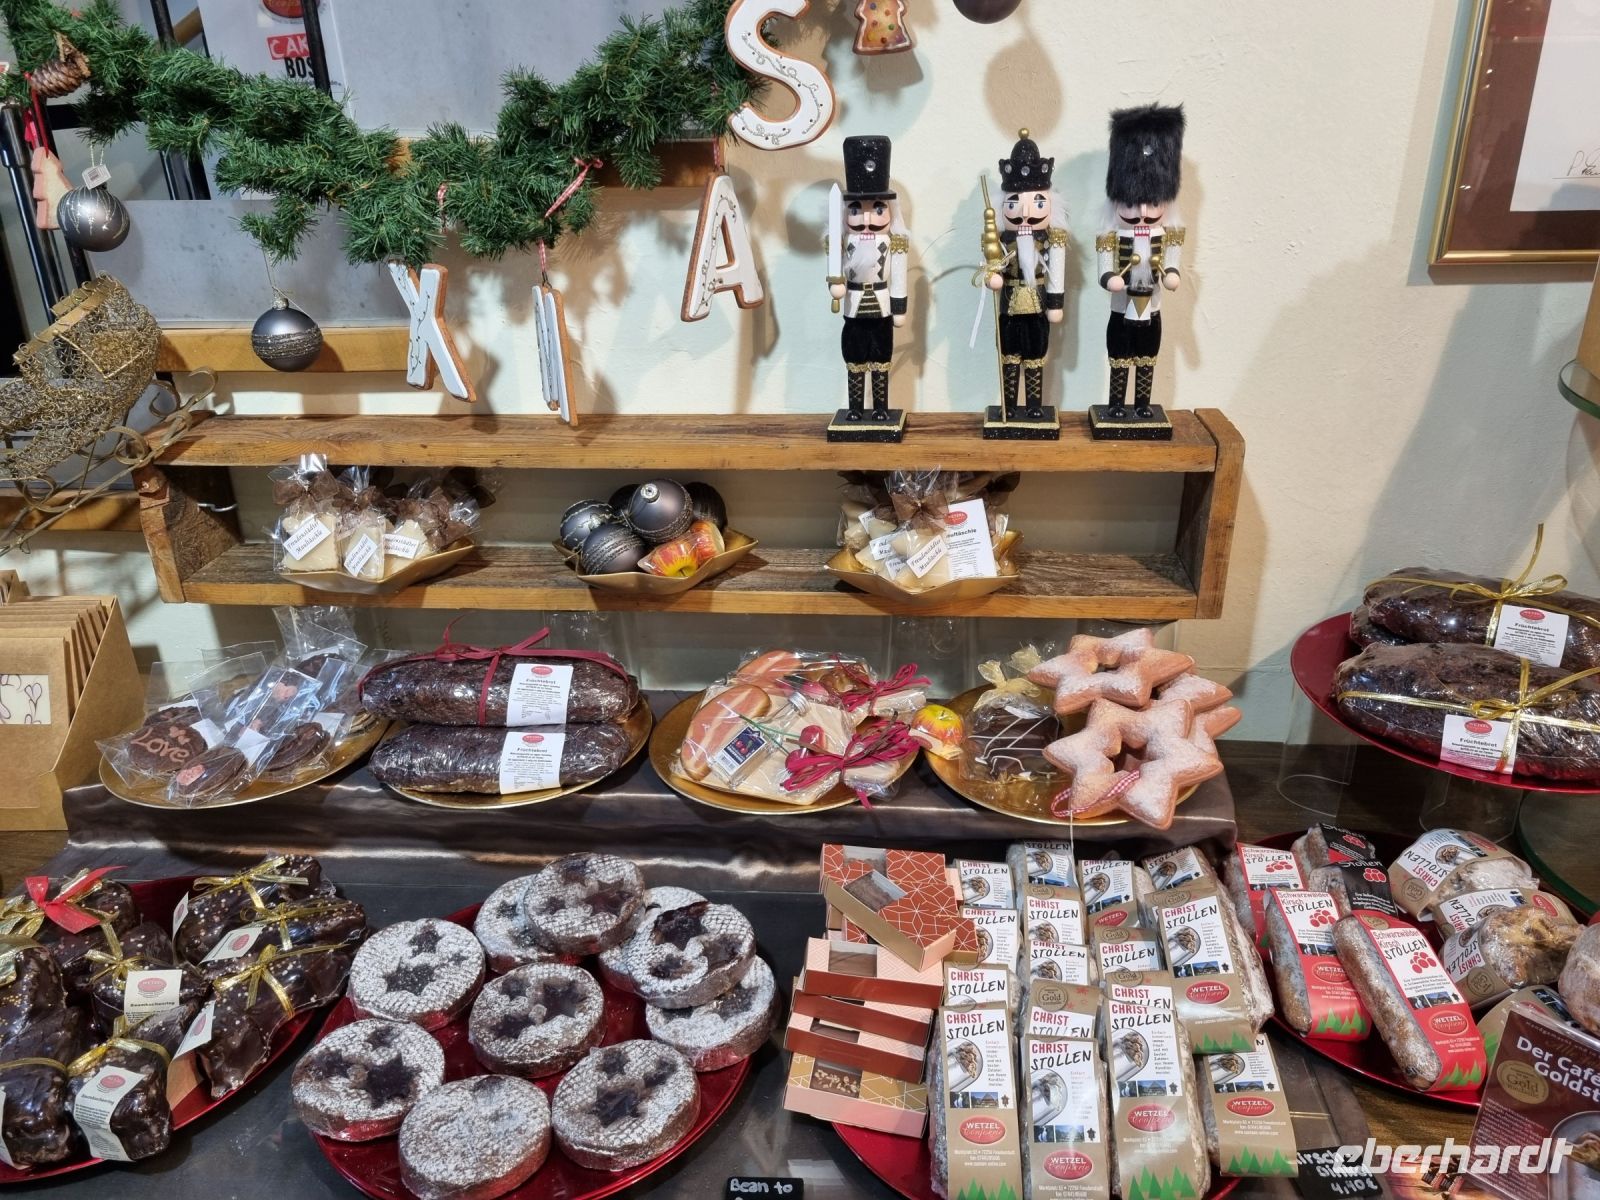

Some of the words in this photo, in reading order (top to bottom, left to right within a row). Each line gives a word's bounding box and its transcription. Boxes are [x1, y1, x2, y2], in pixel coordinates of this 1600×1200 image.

[269, 35, 310, 59] CAK
[284, 56, 316, 79] BOS
[130, 728, 191, 763] Love
[1245, 854, 1293, 864] STOLLEN
[1404, 850, 1448, 879] STOLLEN
[963, 868, 1008, 877] STOLLEN
[1083, 862, 1130, 876] STOLLEN
[1412, 865, 1439, 888] CHRIST
[1029, 899, 1060, 910] CHRIST
[1164, 903, 1197, 918] CHRIST
[1286, 900, 1333, 914] STOLLEN
[976, 915, 1016, 925] OLLEN
[1029, 909, 1079, 920] STOLLEN
[1165, 905, 1218, 929] STOLLEN
[1033, 940, 1065, 950] CHRIST
[1102, 943, 1135, 955] CHRIST
[1384, 938, 1428, 960] STOLLEN
[1032, 948, 1086, 959] STOLLEN
[1102, 948, 1156, 968] STOLLEN
[1459, 953, 1482, 975] CHRIST
[950, 971, 985, 982] CHRIST
[950, 980, 1006, 997] STOLLEN
[1114, 987, 1150, 999] CHRIST
[1191, 985, 1225, 993] WETZEL
[1042, 993, 1061, 1002] Gold
[1112, 1003, 1148, 1015] CHRIST
[946, 1013, 982, 1024] CHRIST
[1033, 1010, 1069, 1026] CHRIST
[1112, 1013, 1172, 1032] STOLLEN
[1433, 1015, 1462, 1024] WETZEL
[946, 1019, 1005, 1040] STOLLEN
[1032, 1043, 1069, 1054] CHRIST
[1517, 1035, 1553, 1062] Der
[1030, 1050, 1092, 1071] STOLLEN
[1506, 1074, 1540, 1093] Gold
[729, 1178, 769, 1193] Bean
[773, 1182, 794, 1195] to
